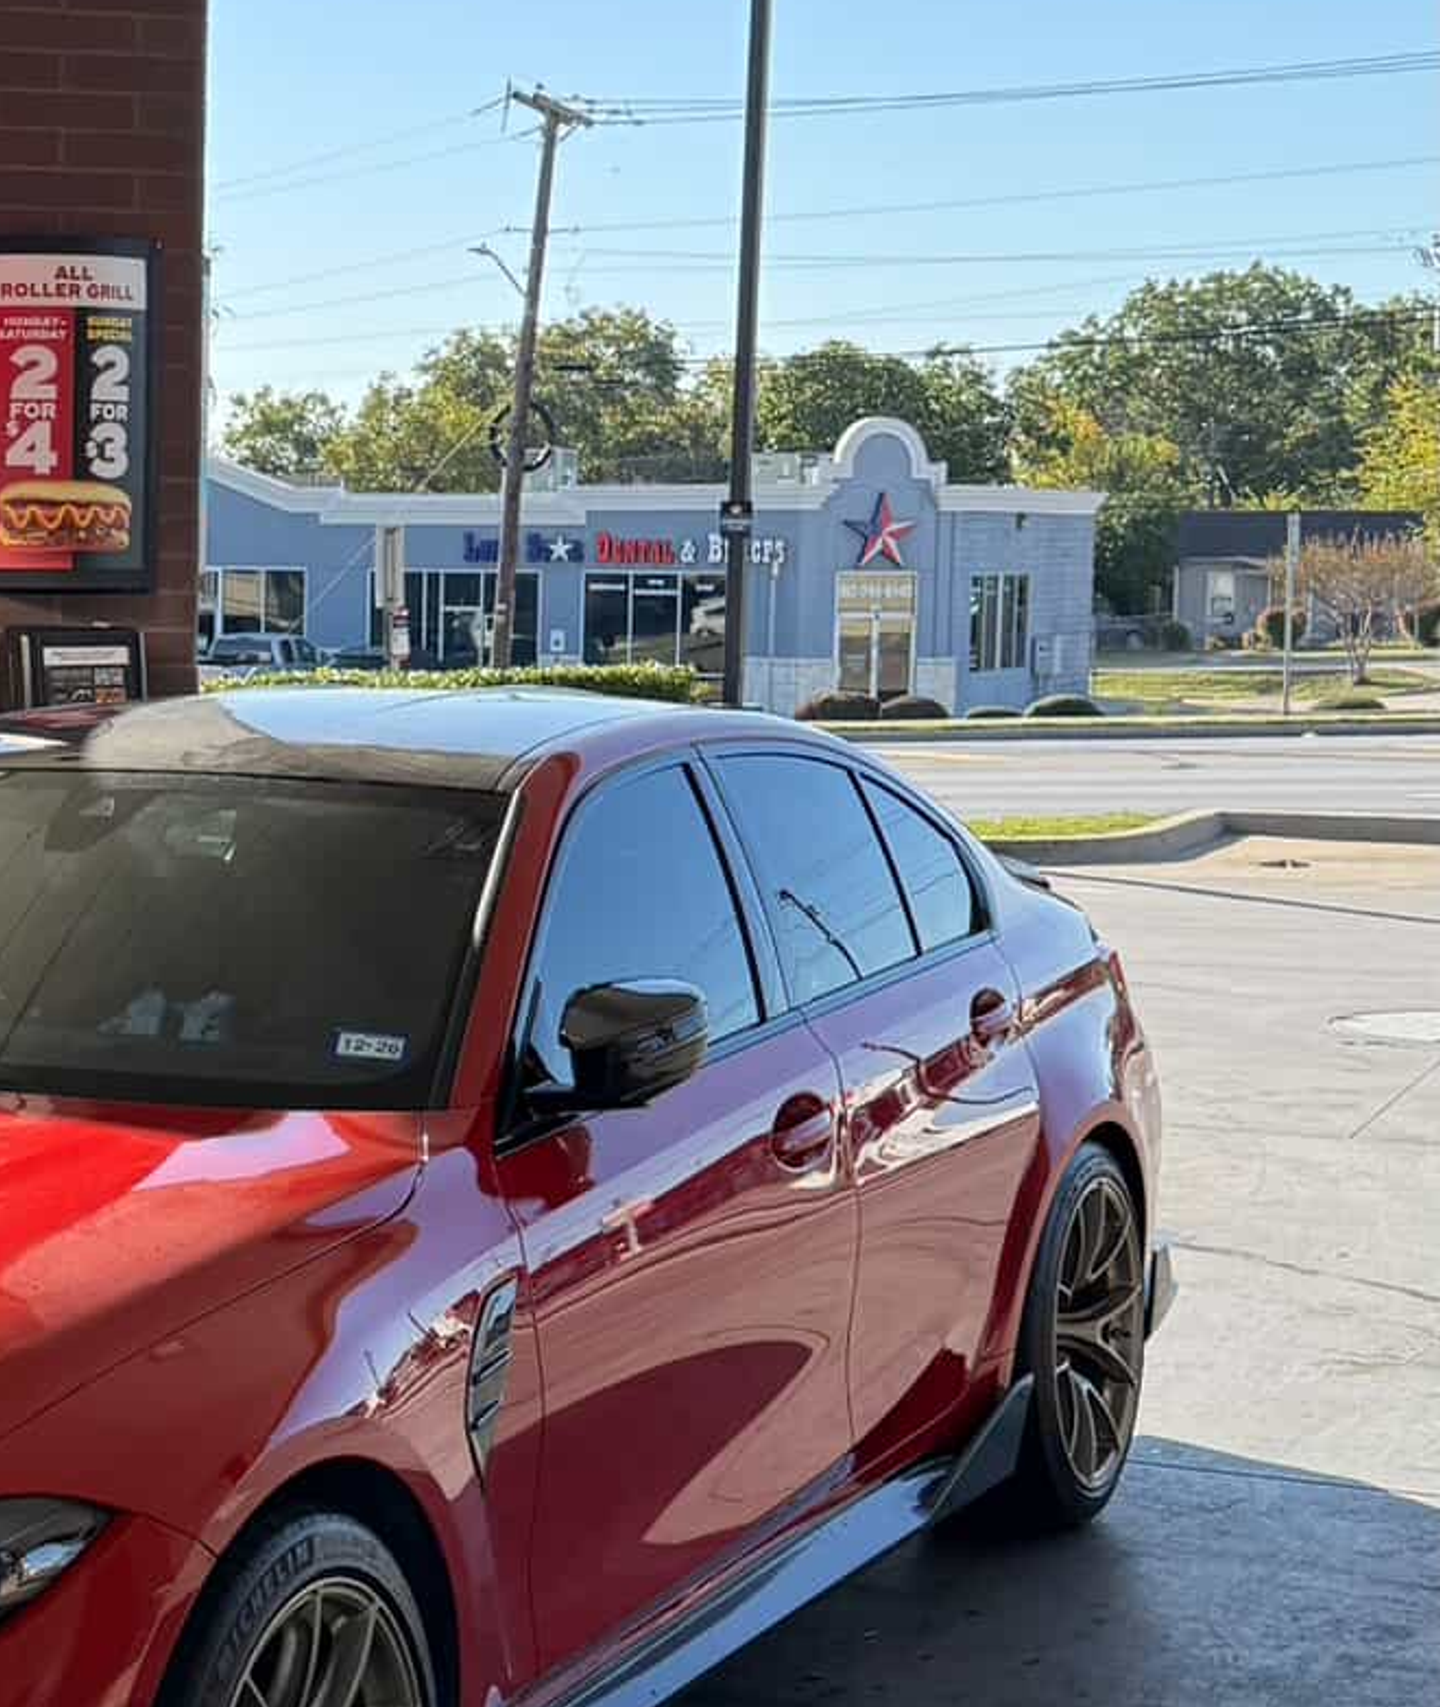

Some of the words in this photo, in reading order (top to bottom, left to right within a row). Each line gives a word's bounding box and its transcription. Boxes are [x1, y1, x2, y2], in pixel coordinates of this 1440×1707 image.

[55, 266, 94, 281] ALL
[0, 283, 81, 298] ROLLER
[87, 285, 134, 301] GRILL
[10, 344, 58, 400] 2
[91, 344, 130, 402] 2
[10, 402, 56, 420] FOR
[91, 403, 128, 422] FOR
[5, 420, 58, 475] $4
[86, 422, 129, 479] $3
[680, 538, 696, 564] &
[707, 533, 786, 564] BCES
